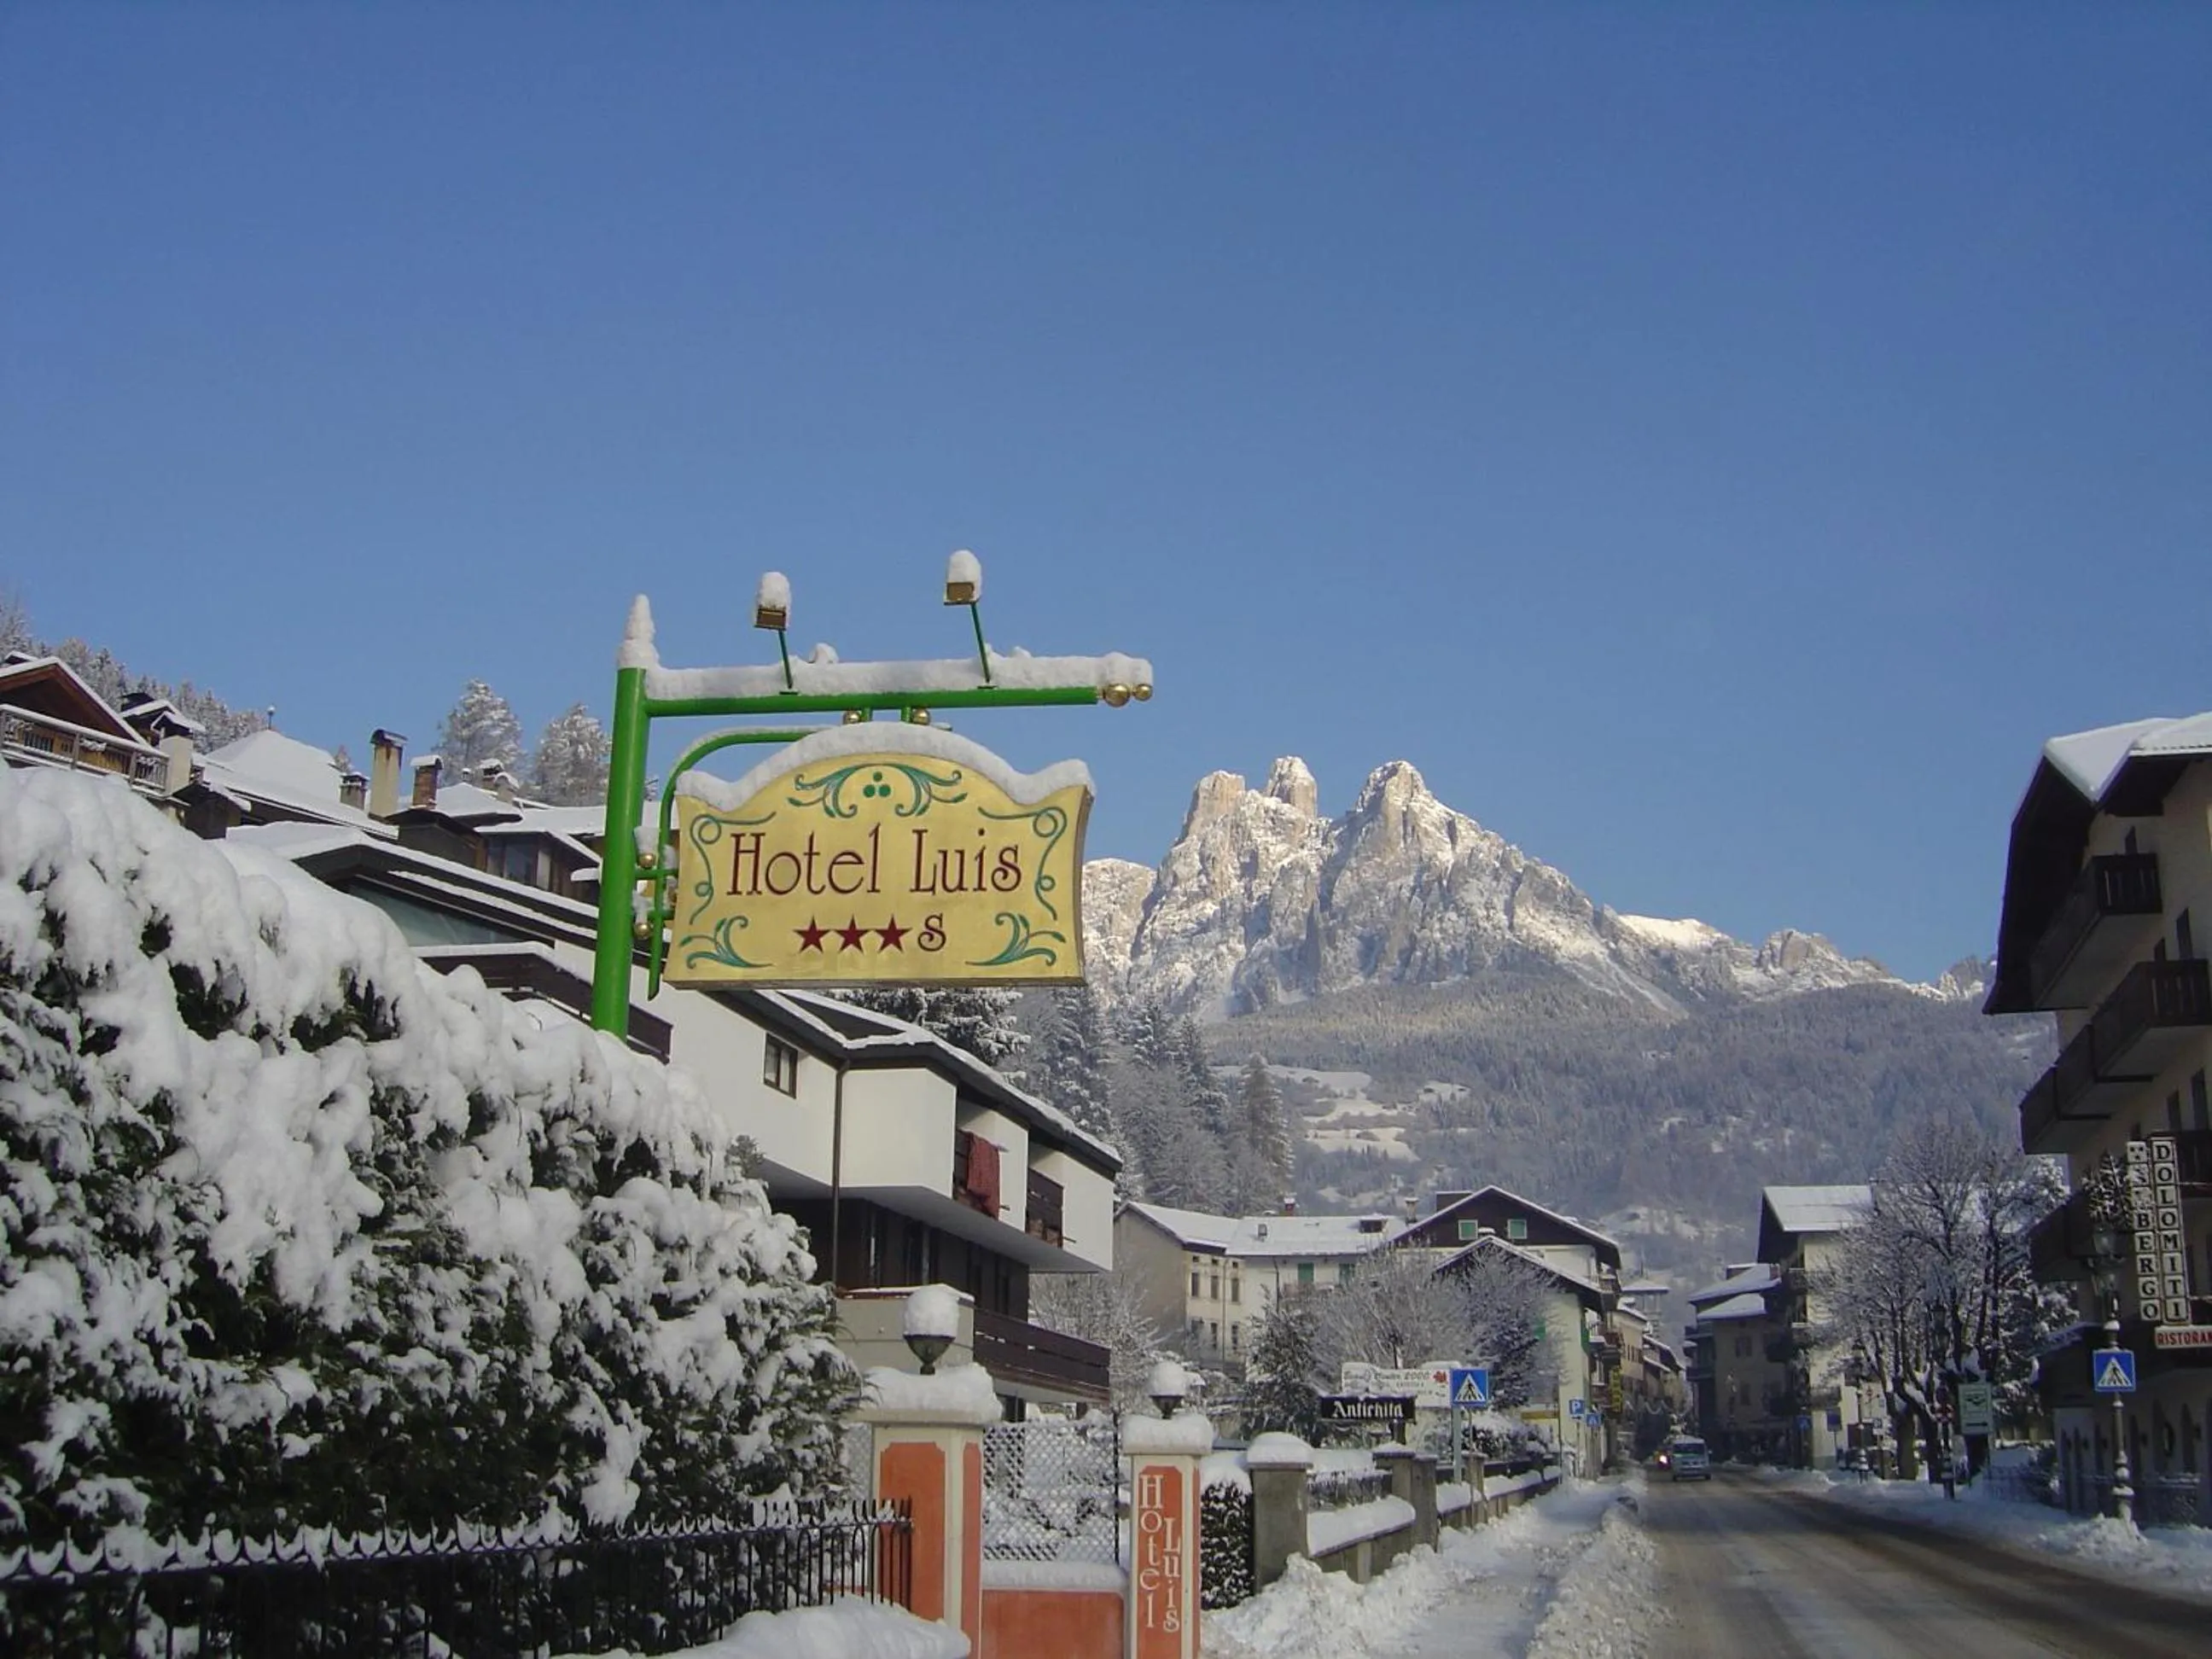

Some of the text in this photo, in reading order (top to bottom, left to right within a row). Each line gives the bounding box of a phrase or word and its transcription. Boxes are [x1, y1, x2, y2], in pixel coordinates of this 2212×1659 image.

[725, 823, 1022, 897] Hotel Luis
[2155, 1145, 2182, 1317] DOLOMITI
[1139, 1475, 1164, 1628] Hotel
[1163, 1516, 1181, 1633] Luis
